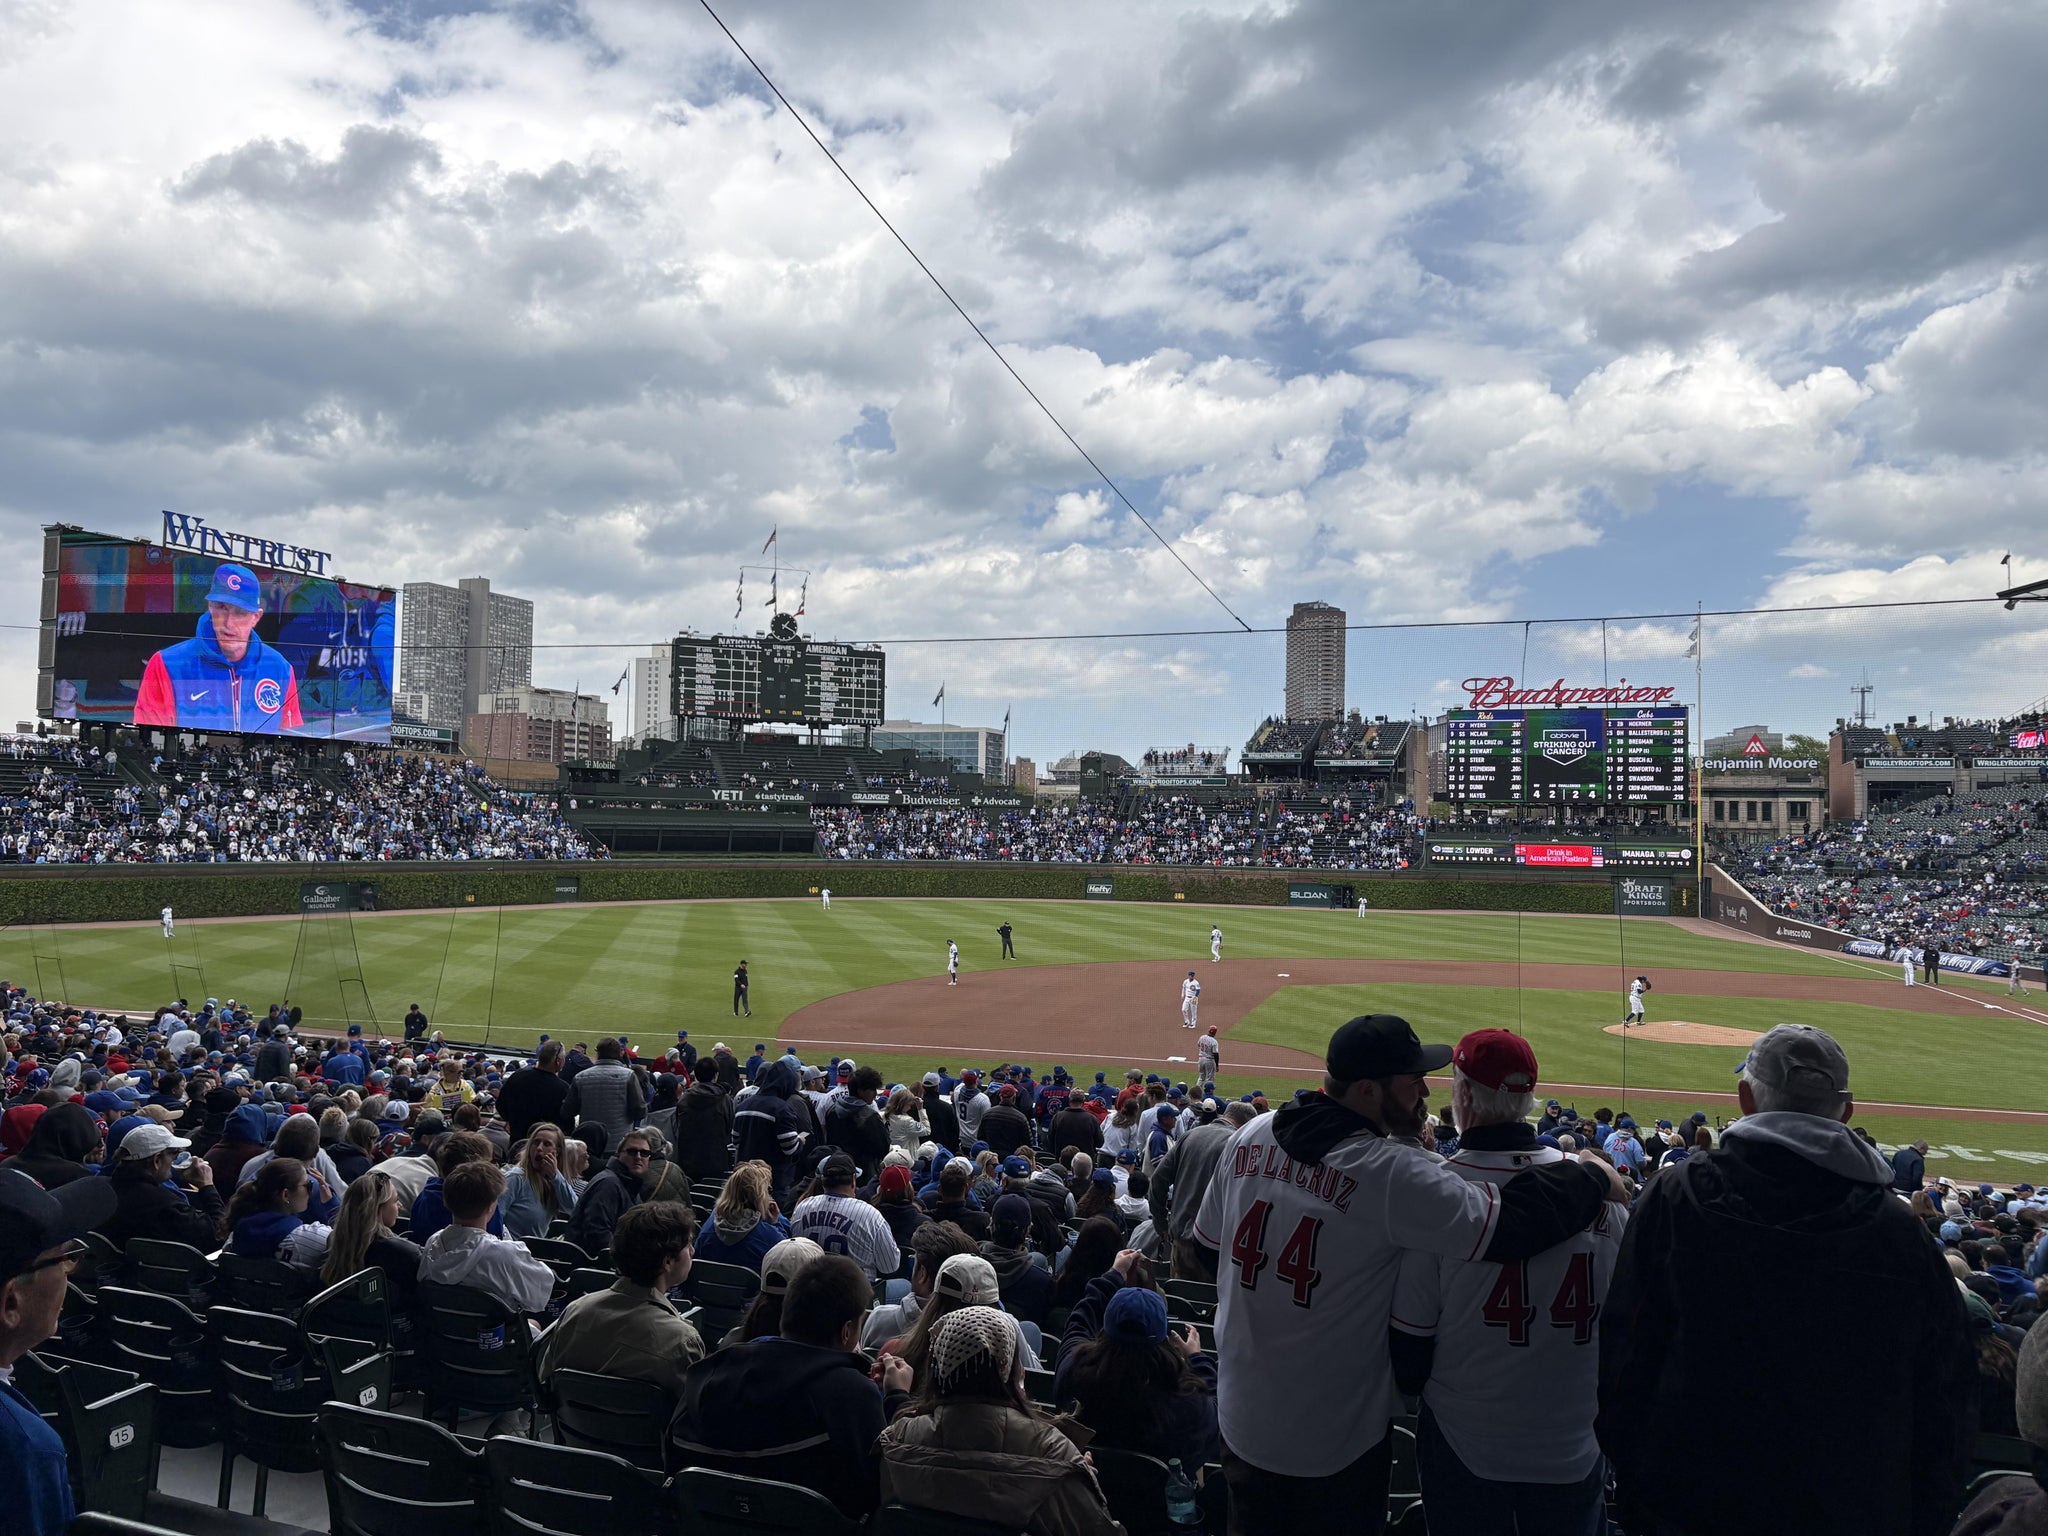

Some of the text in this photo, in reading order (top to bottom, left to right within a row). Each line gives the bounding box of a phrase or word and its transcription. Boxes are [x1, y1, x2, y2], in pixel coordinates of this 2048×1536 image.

[162, 509, 332, 576] WINTRUST
[718, 638, 762, 649] NATIONAL
[806, 644, 848, 655] AMERICAN
[1462, 676, 1675, 709] Budweiser
[1478, 712, 1494, 720] Reds
[1637, 710, 1654, 718] Cubs
[593, 760, 616, 769] Mobile
[1695, 757, 1818, 771] Benjamin Moore
[712, 789, 743, 800] YETI
[761, 793, 804, 802] tastytrade
[1533, 790, 1540, 798] 4
[1549, 790, 1556, 798] 2
[982, 797, 1020, 806] Advocate
[1622, 850, 1655, 858] IMANAGA
[1089, 885, 1111, 893] Hefty
[1623, 885, 1664, 894] DRAFT
[303, 895, 340, 903] Gallagher
[1850, 941, 1878, 955] Reynolds
[1948, 956, 1971, 971] Wrap
[1613, 1138, 1626, 1153] 25
[1234, 1145, 1359, 1213] DE LA CRUZ
[802, 1211, 853, 1235] ARRIETA
[1231, 1200, 1324, 1309] 44
[1482, 1252, 1600, 1347] 44
[362, 1391, 374, 1402] 14
[115, 1430, 128, 1444] 15
